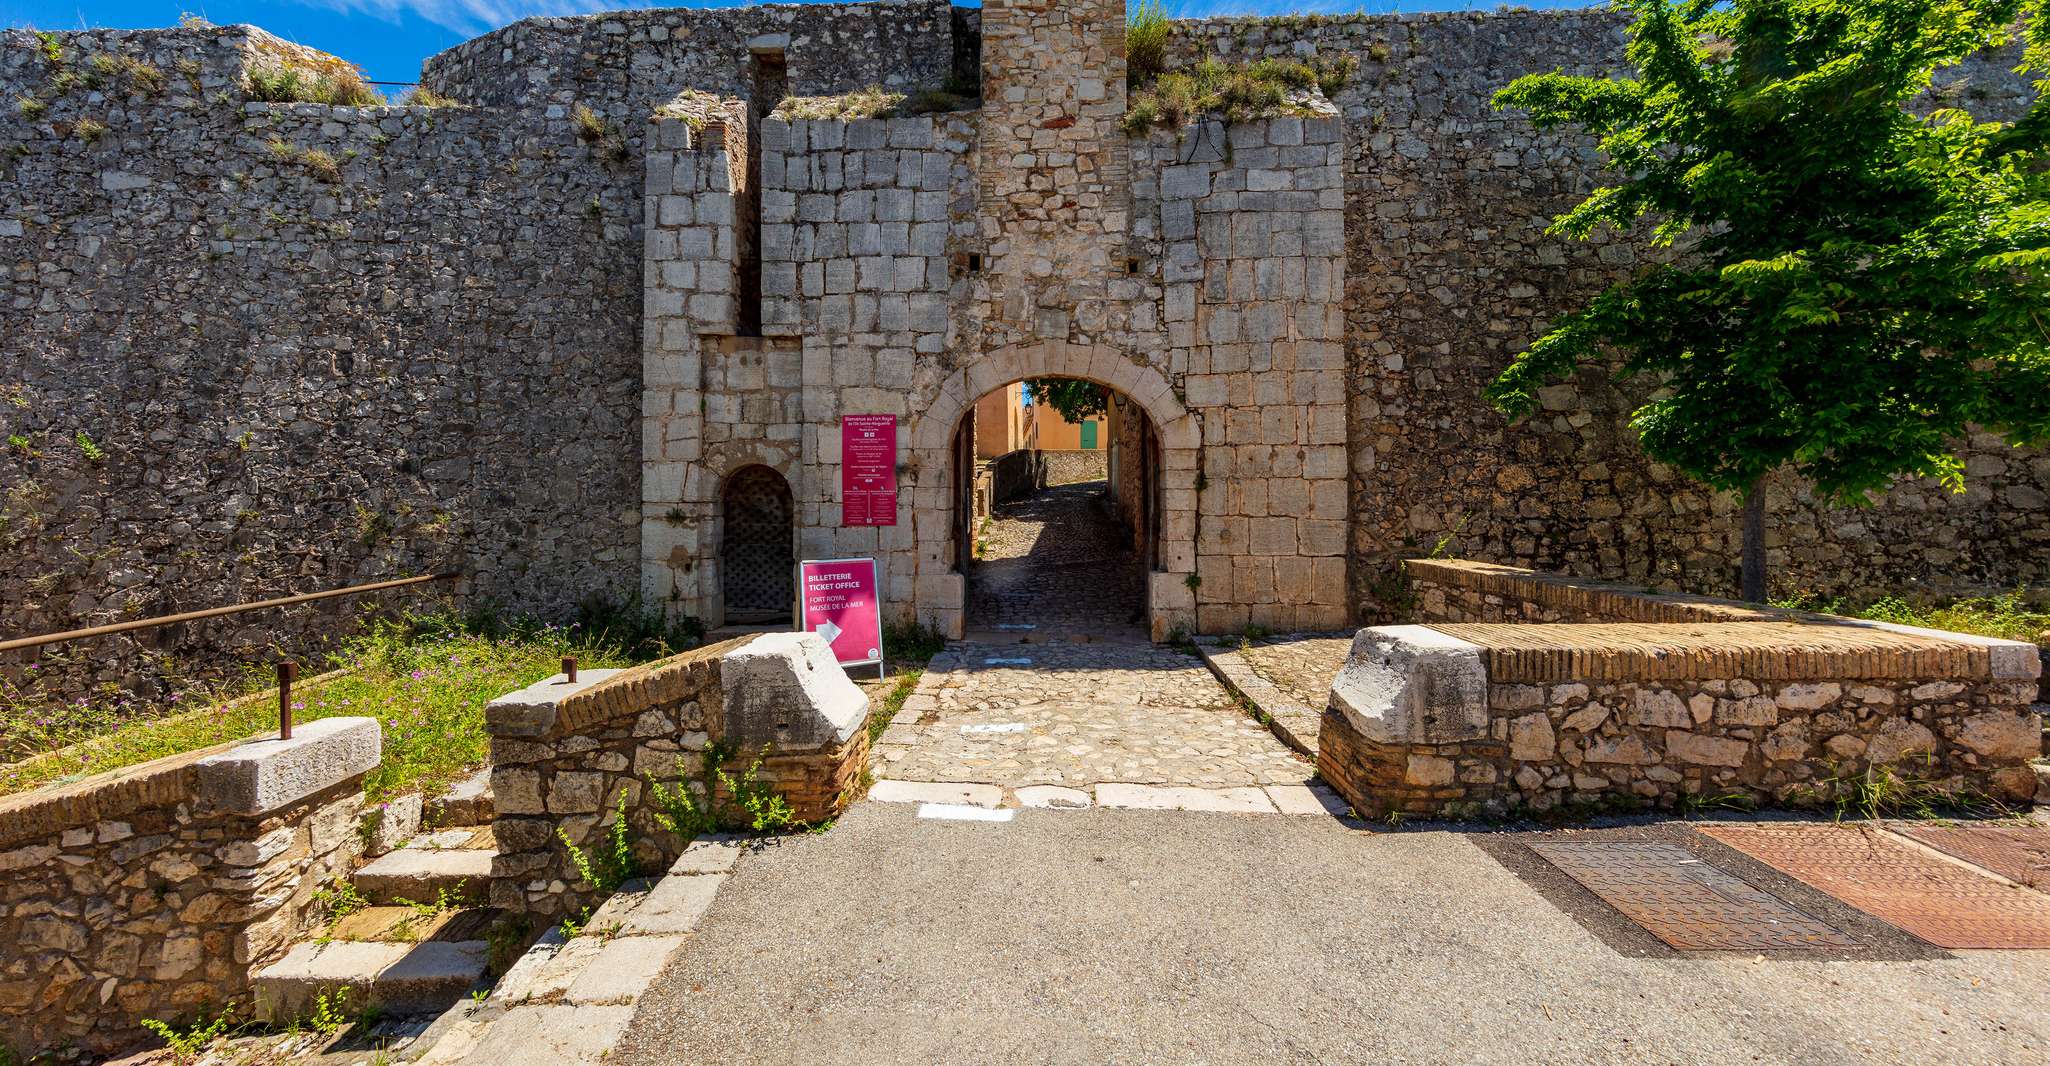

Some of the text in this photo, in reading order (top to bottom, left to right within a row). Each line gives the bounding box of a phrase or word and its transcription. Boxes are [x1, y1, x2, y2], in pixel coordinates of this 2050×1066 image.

[808, 573, 852, 582] BILLETTERIE
[809, 581, 860, 591] TICKET OFFICE
[810, 603, 832, 611] MUSÉE
